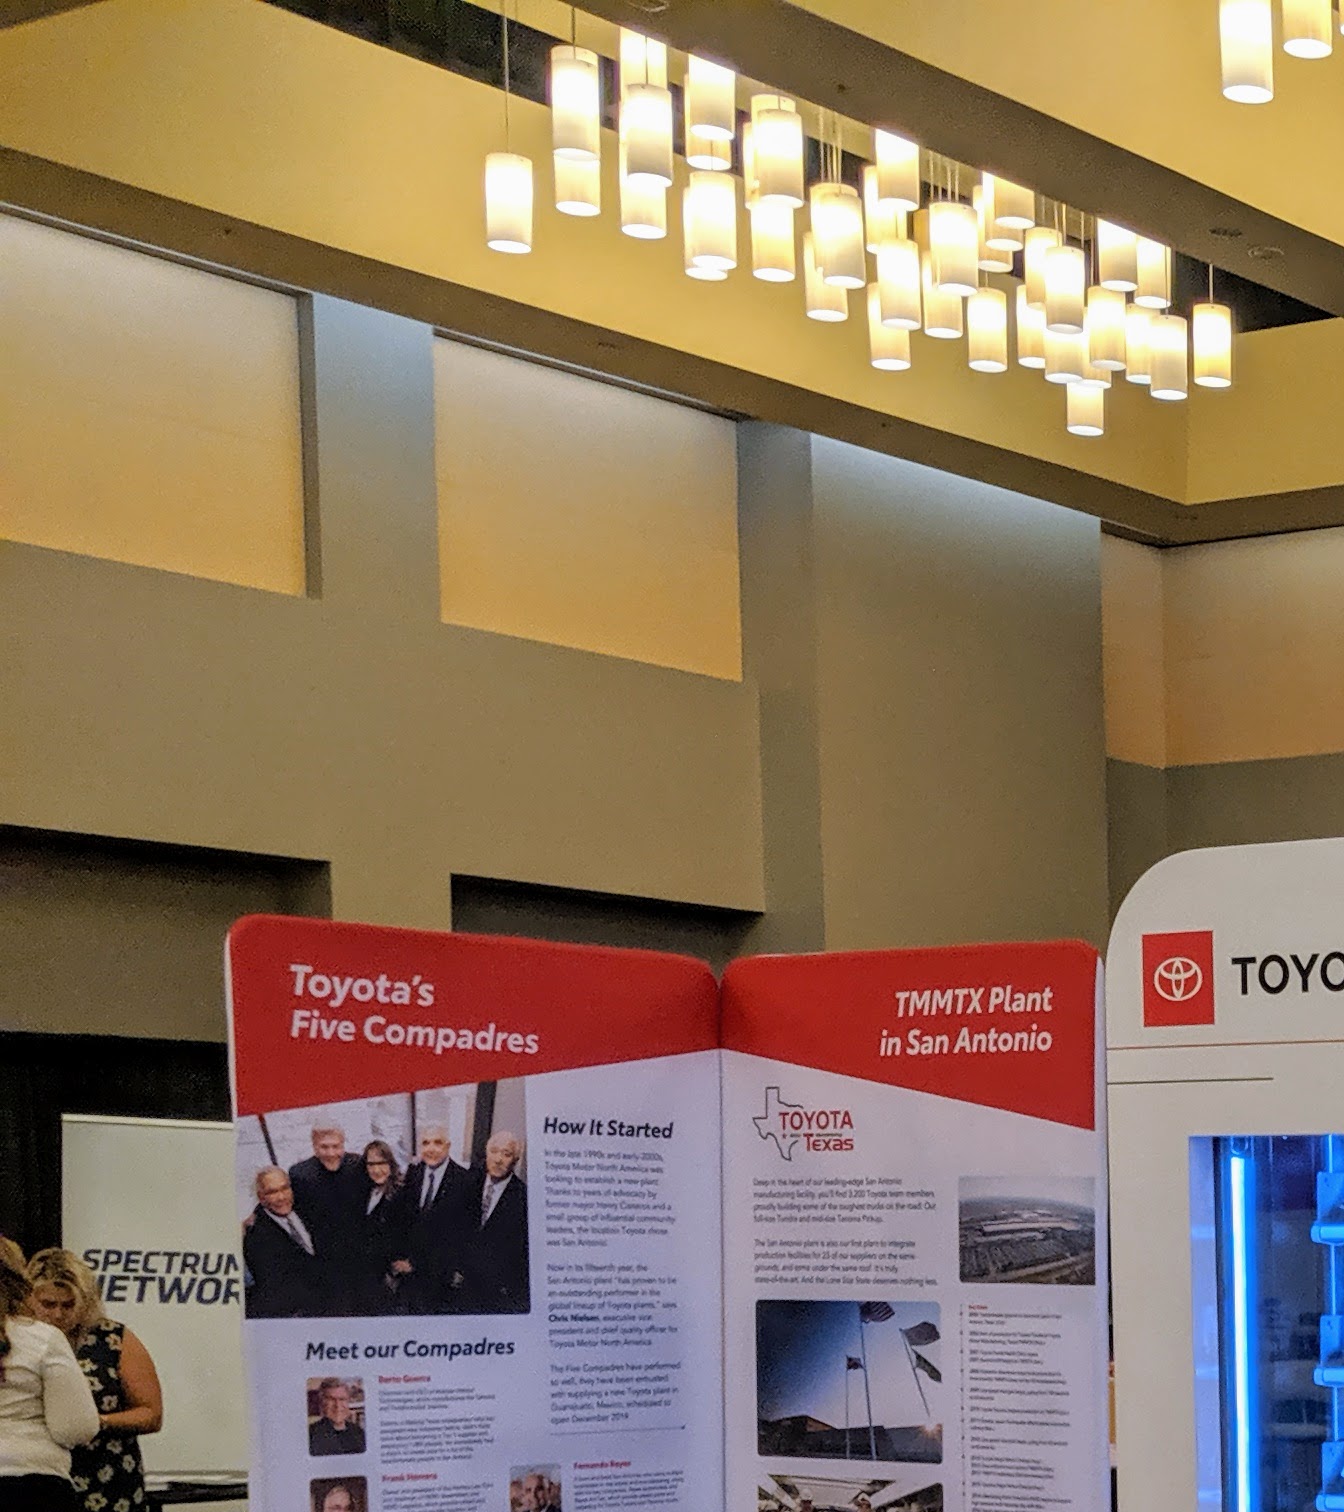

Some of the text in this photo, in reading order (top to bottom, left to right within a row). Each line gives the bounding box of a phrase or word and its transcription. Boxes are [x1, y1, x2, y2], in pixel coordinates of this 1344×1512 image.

[288, 963, 435, 1007] Toyota's
[895, 984, 1053, 1018] TMMTX Plant
[290, 1010, 539, 1055] Five Compadres
[879, 1023, 1053, 1056] in San Antonio
[544, 1117, 674, 1138] How It Started
[779, 1110, 854, 1130] TOYOTA
[803, 1133, 854, 1151] Texas
[96, 1274, 240, 1305] ETWOR
[306, 1337, 516, 1362] Meet our Compadres
